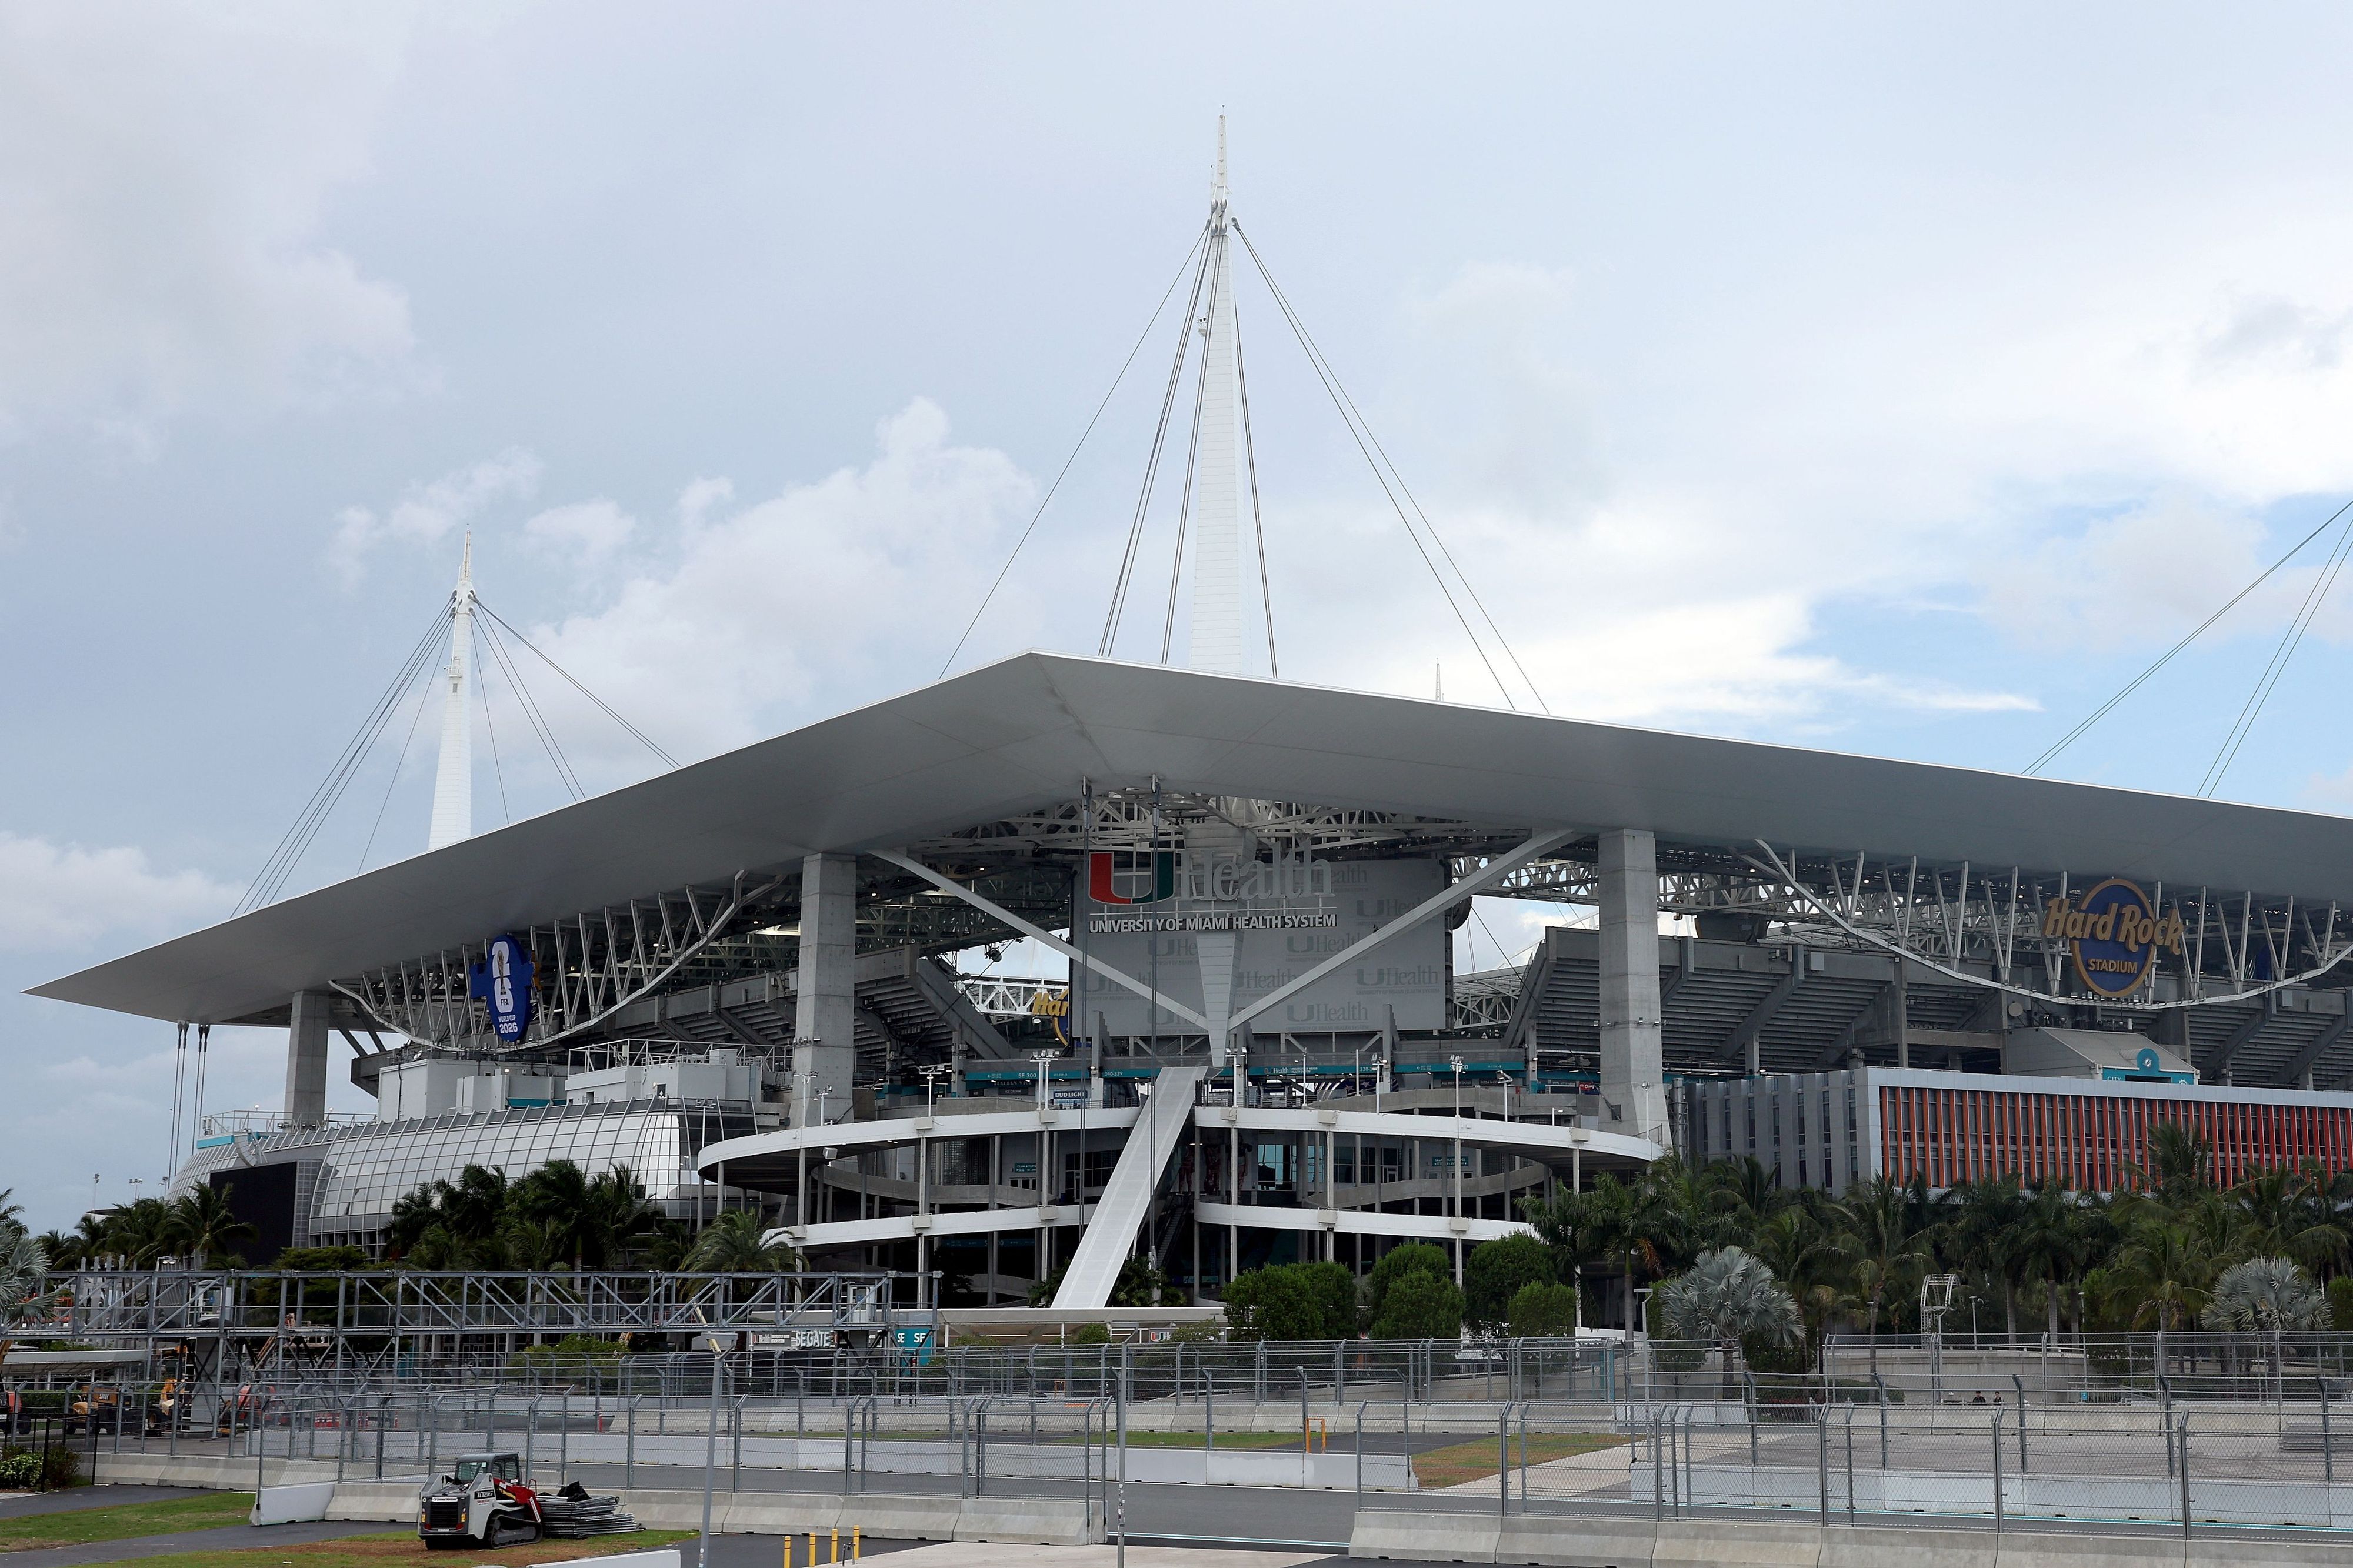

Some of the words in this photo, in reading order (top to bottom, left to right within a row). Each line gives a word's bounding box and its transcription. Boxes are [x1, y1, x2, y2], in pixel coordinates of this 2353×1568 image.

[1089, 919, 1164, 933] UNIVERSITY
[1165, 919, 1183, 932] OF
[1186, 917, 1229, 931] MIAMI
[1233, 915, 1281, 929] HEALTH
[1285, 914, 1336, 928] SYSTEM
[2044, 898, 2119, 941] Hard
[2118, 904, 2184, 955] Rock
[2088, 958, 2138, 974] STADIUM
[501, 998, 509, 1006] FIFA
[1032, 992, 1069, 1016] Har
[499, 1022, 518, 1034] 2026
[796, 1330, 806, 1347] SE
[806, 1330, 829, 1347] GATE
[897, 1332, 905, 1343] SE
